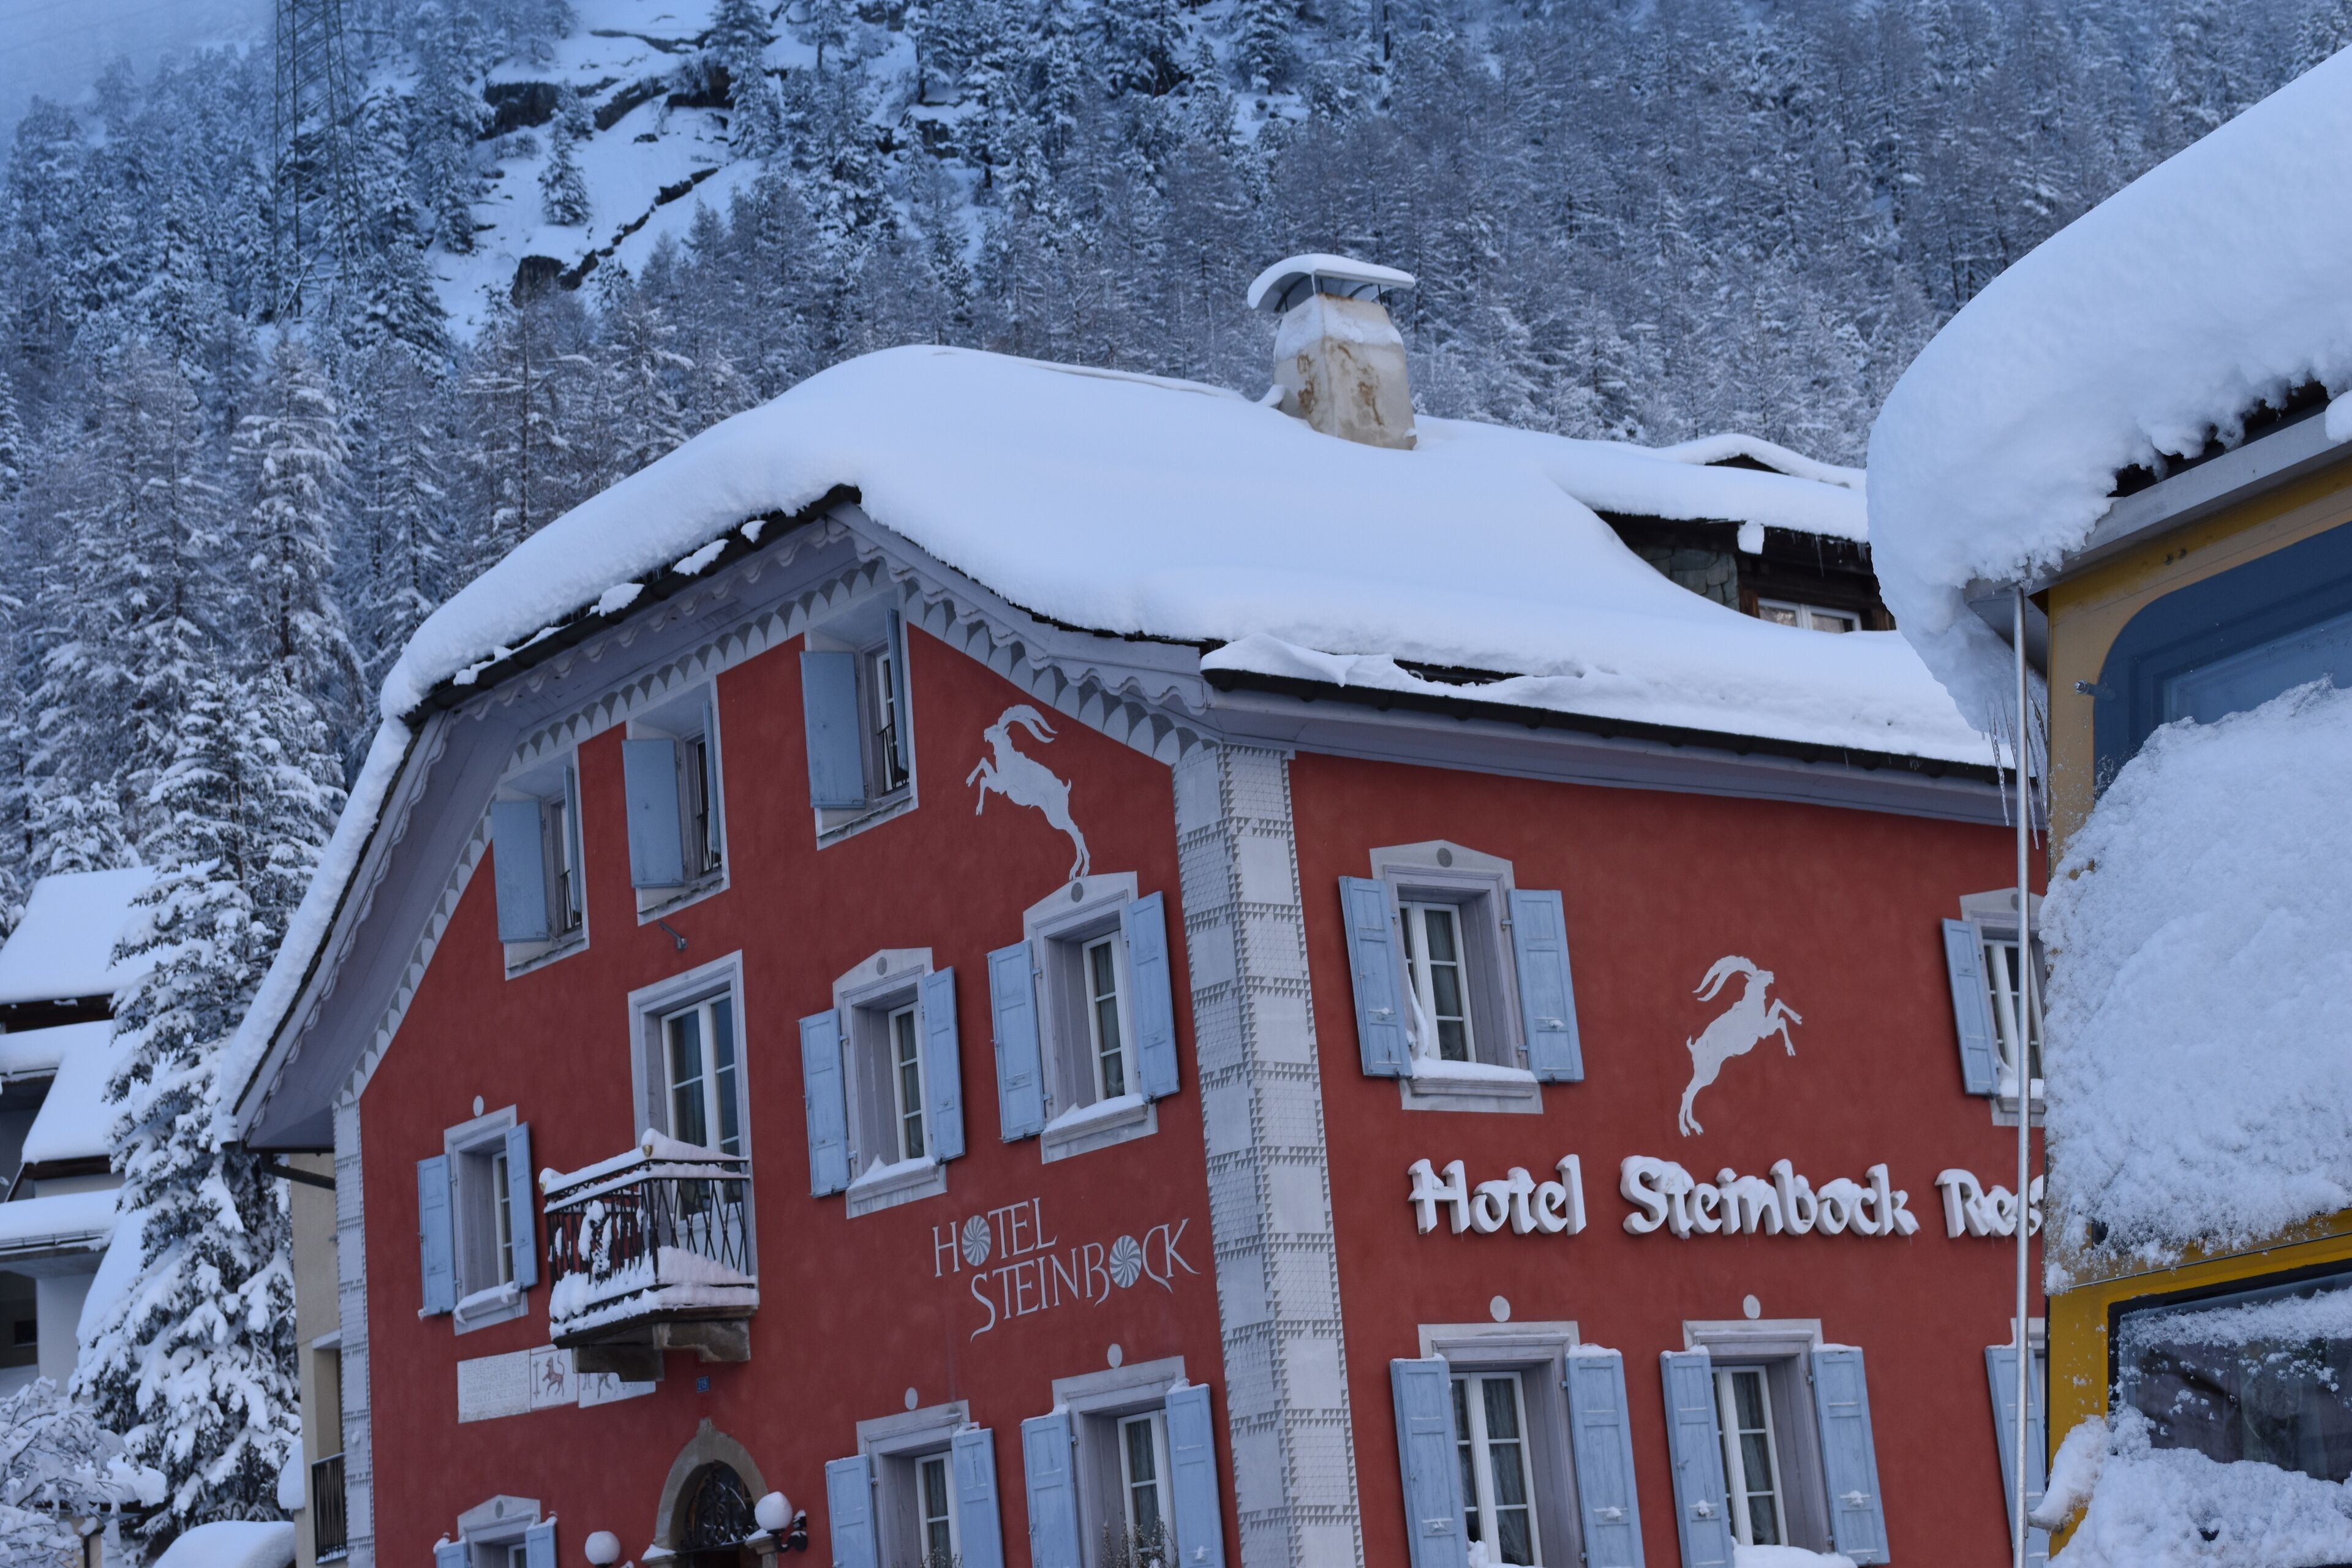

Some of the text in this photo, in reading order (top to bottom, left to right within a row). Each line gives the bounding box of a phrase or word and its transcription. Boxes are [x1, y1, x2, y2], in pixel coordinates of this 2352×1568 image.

[1407, 1153, 1587, 1236] Hotel
[1619, 1155, 1920, 1237] Steinbock
[932, 1197, 1058, 1278] HOTEL
[970, 1218, 1202, 1343] STEINBOCK
